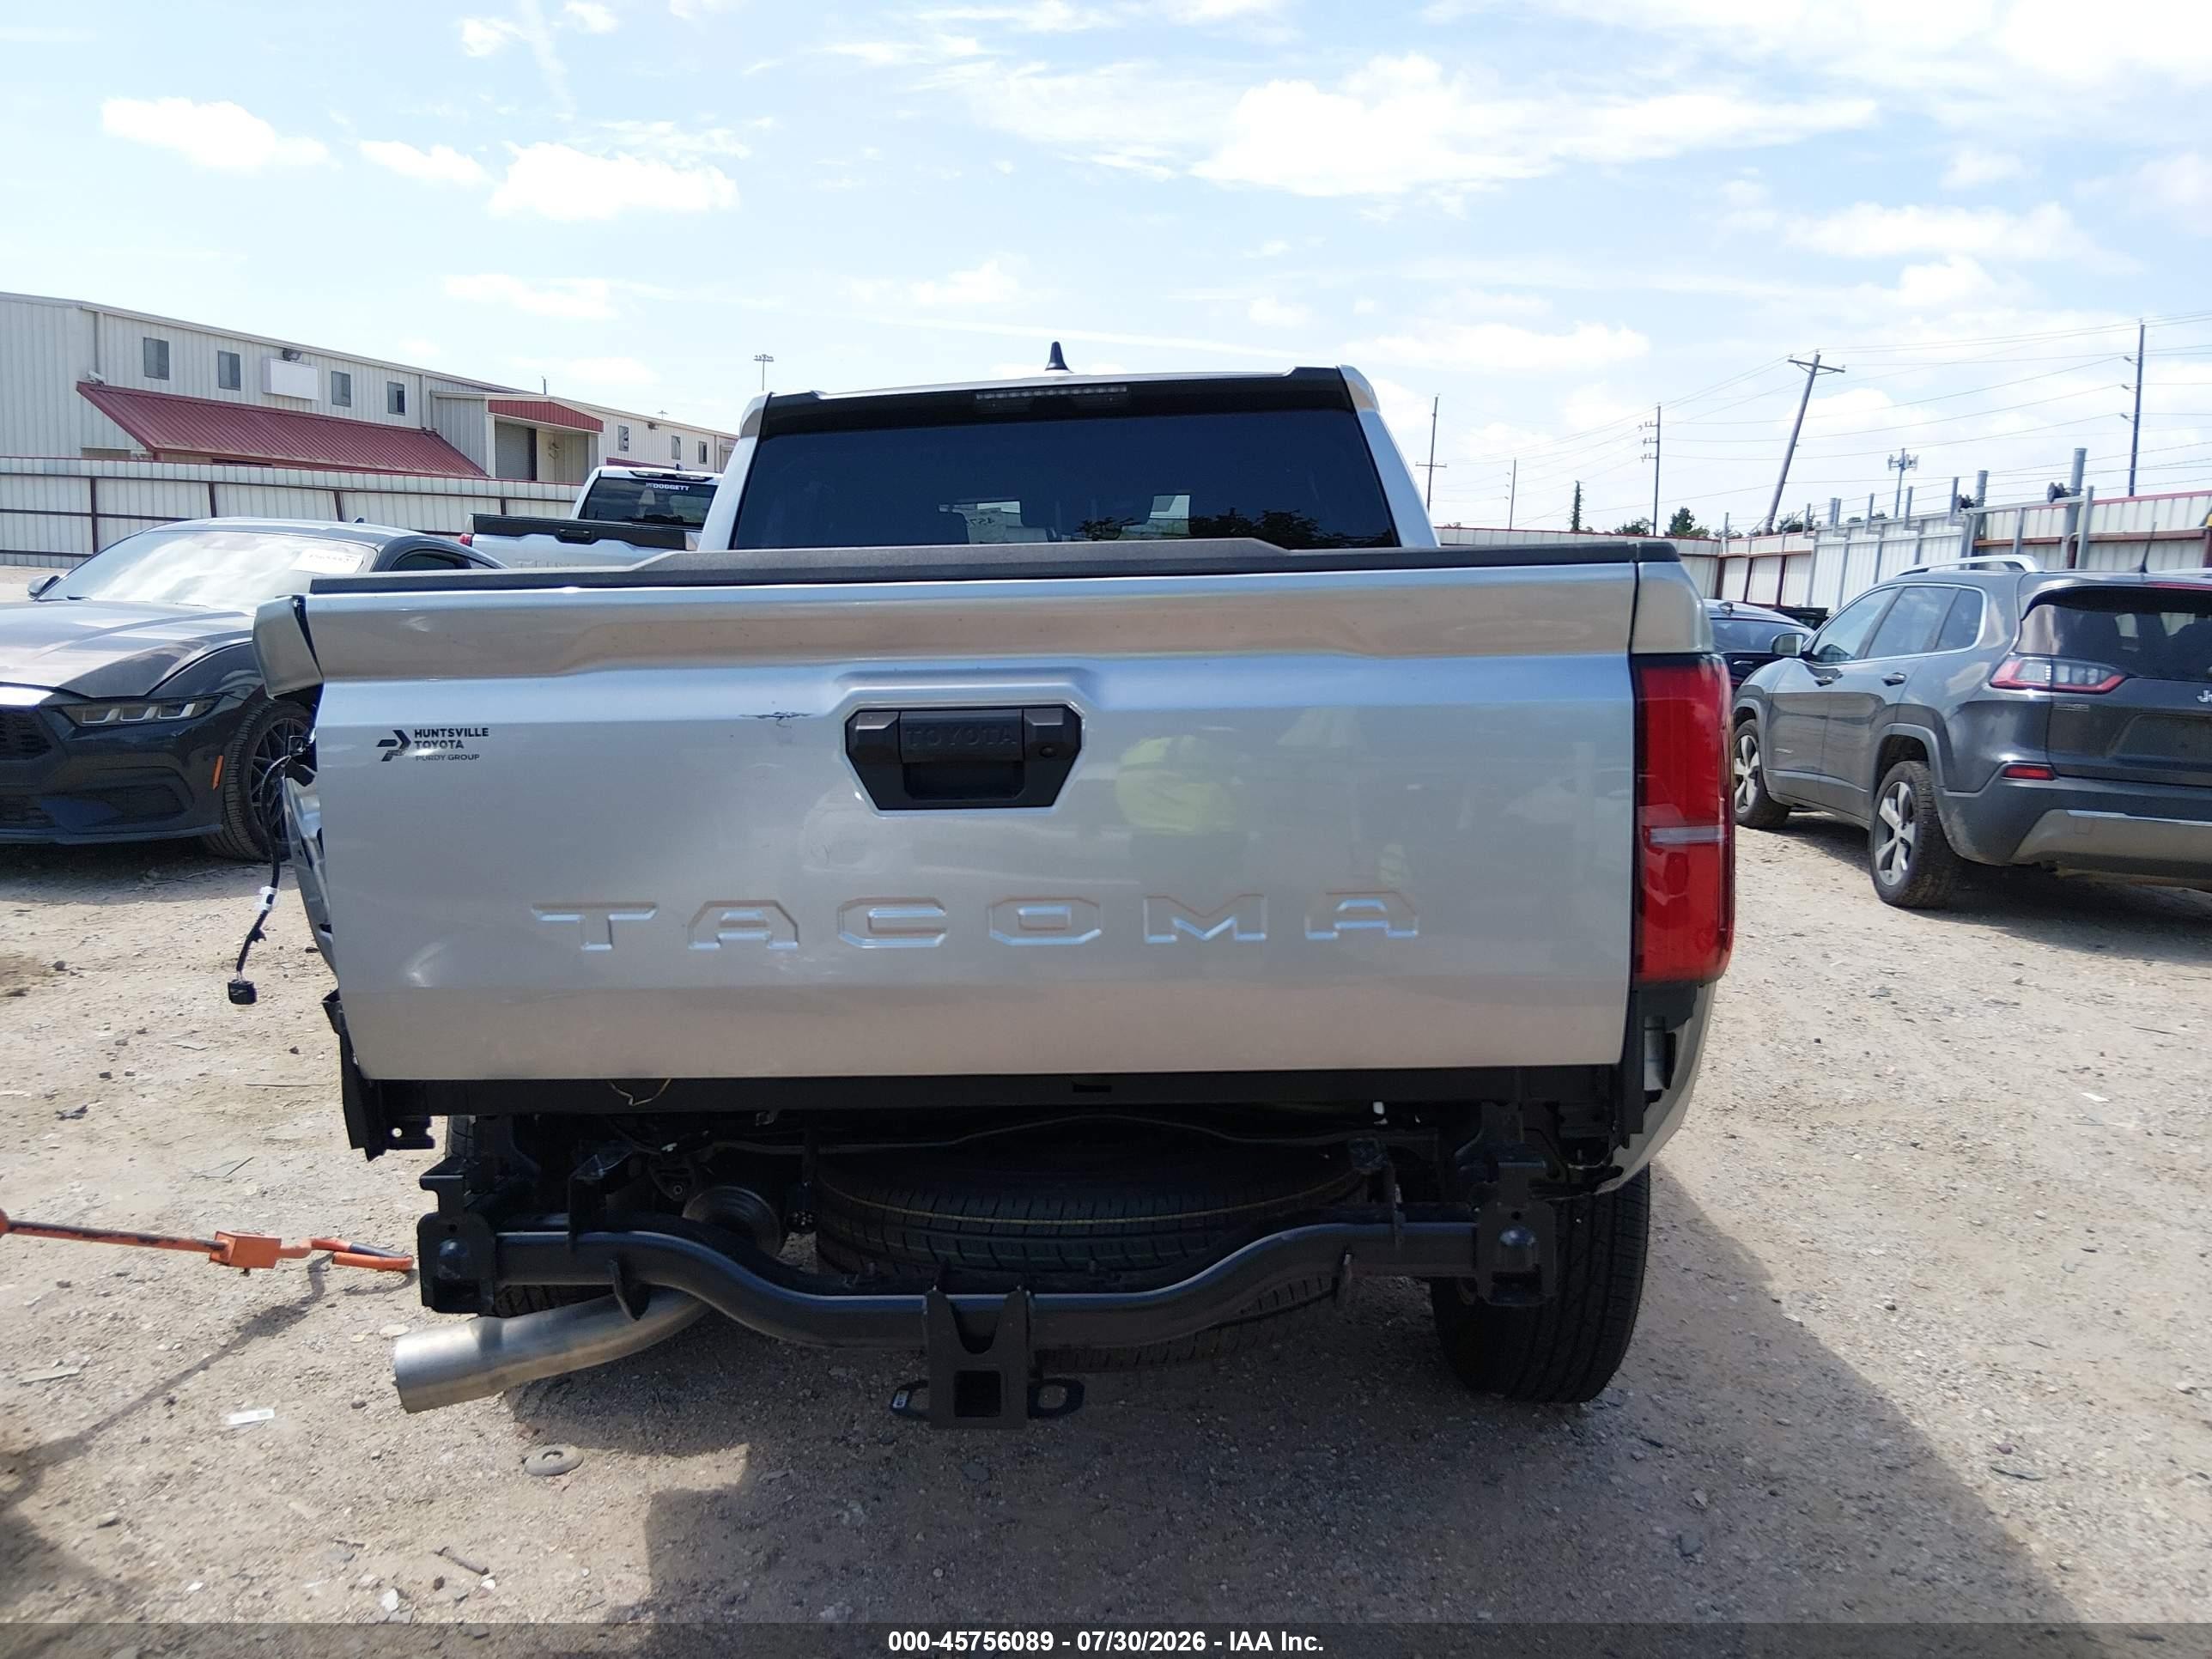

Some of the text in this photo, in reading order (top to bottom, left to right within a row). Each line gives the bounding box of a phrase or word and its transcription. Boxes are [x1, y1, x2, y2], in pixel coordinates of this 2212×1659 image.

[414, 727, 489, 738] HUNTSVILLE
[905, 726, 1018, 746] TOYOTA
[414, 739, 465, 750] TOYOTA
[531, 891, 1419, 951] TACOMA
